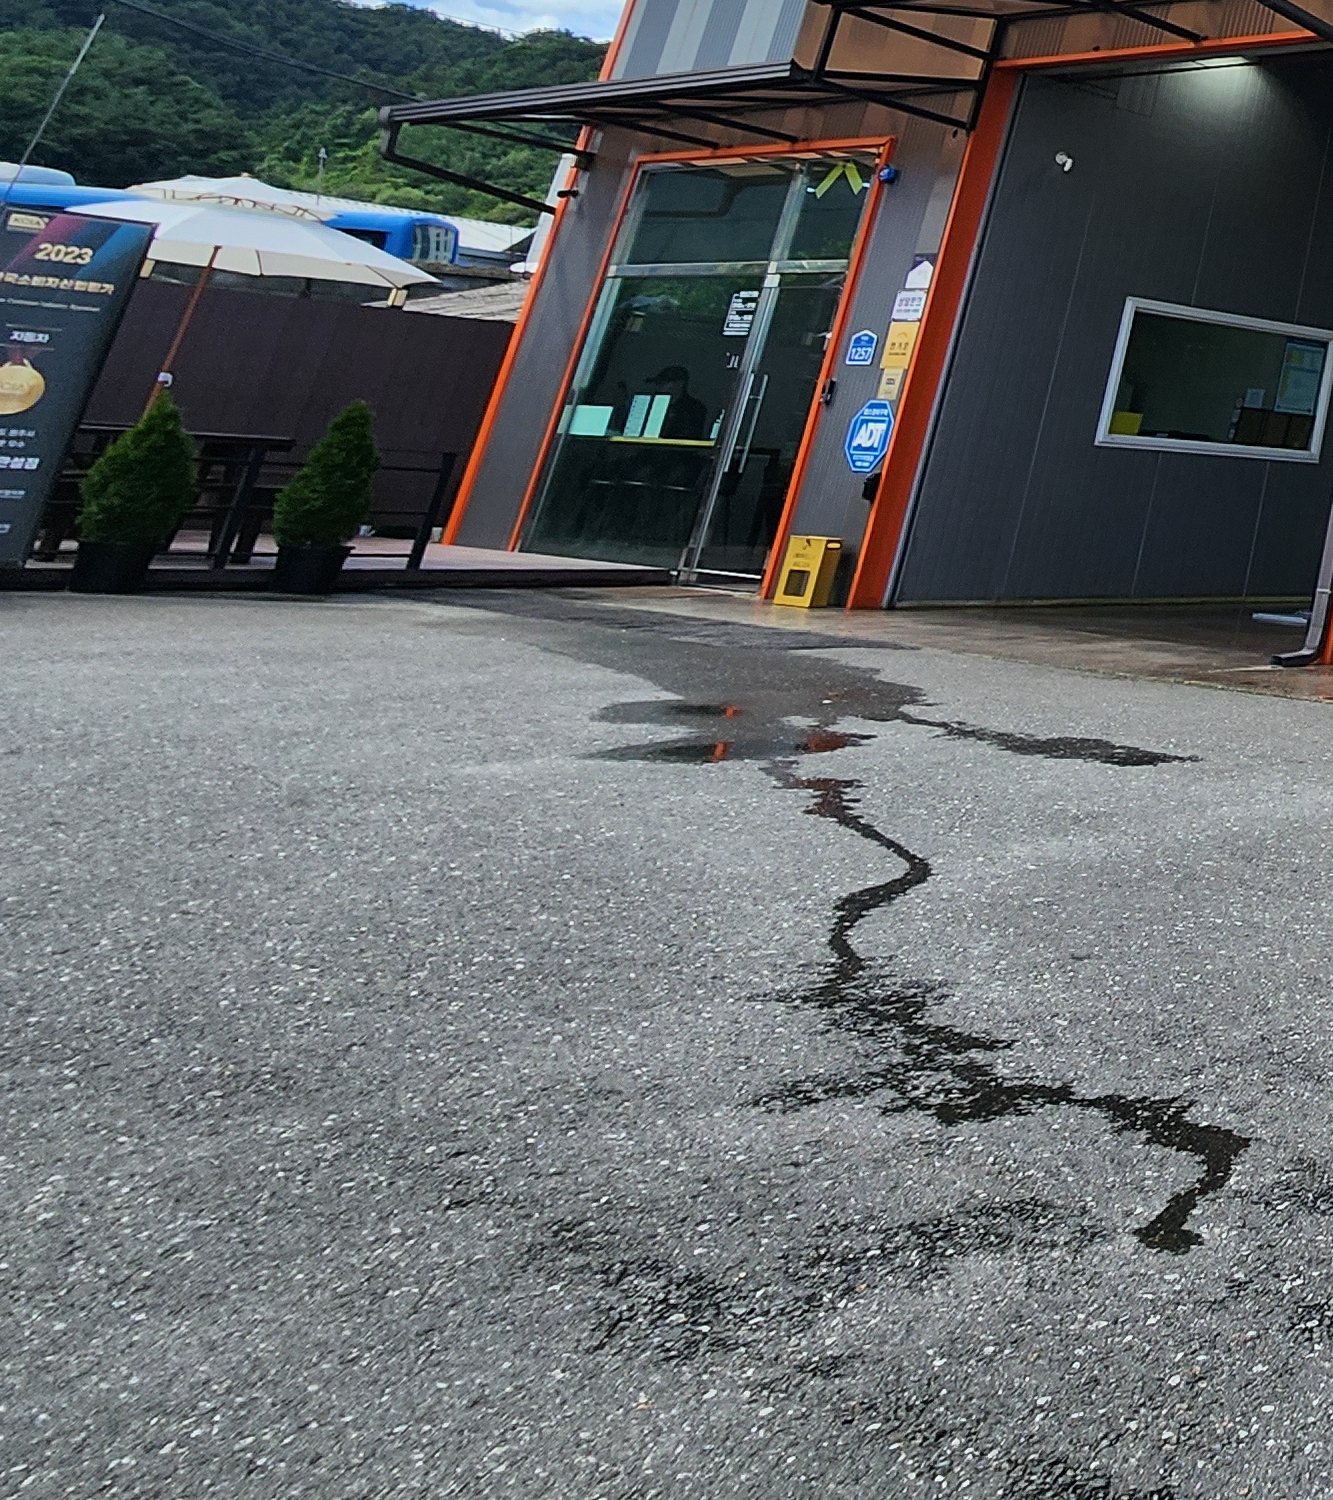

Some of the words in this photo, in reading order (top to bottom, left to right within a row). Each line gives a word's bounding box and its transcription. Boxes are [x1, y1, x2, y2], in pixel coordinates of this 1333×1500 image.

[34, 243, 93, 265] 2023
[0, 271, 115, 295] 국소비자산업평가
[10, 331, 49, 343] 자동차
[852, 422, 887, 448] ADT
